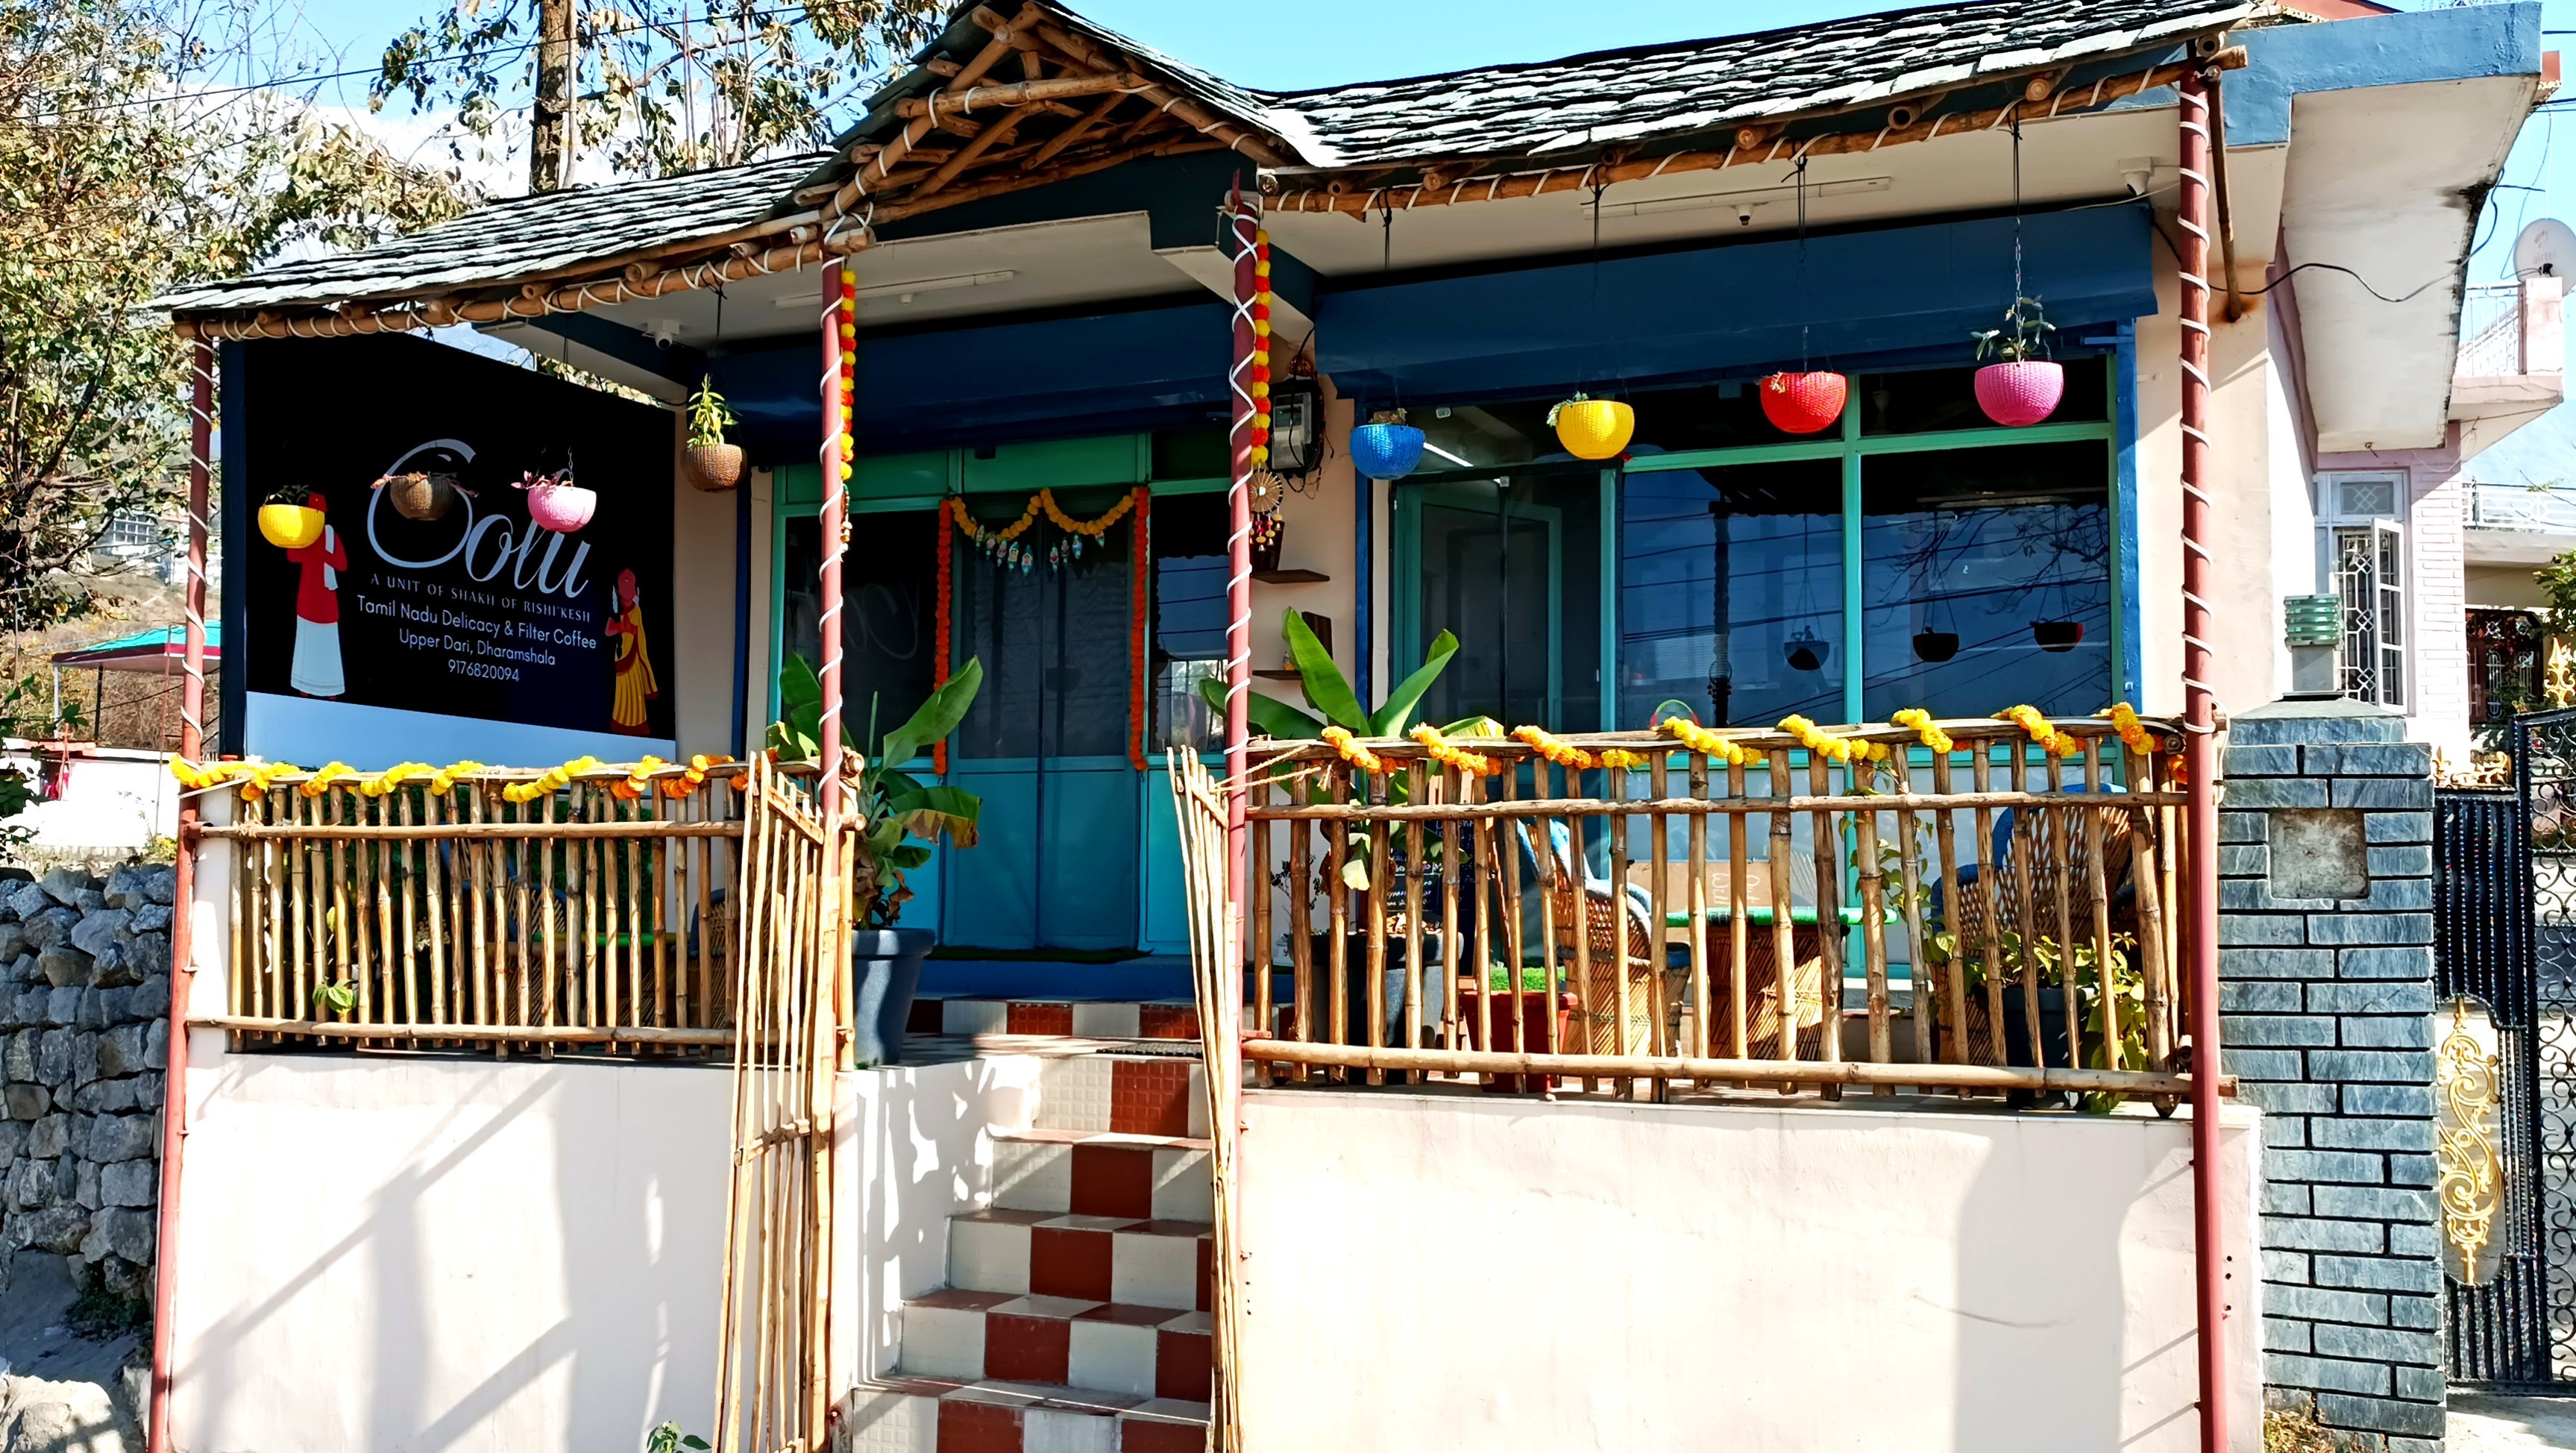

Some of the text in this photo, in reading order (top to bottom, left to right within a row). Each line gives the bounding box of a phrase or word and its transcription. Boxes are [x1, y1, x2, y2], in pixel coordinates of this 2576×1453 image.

[371, 573, 379, 586] A
[387, 576, 420, 591] UNIT
[427, 583, 444, 596] OF
[451, 588, 495, 606] SHAKH
[501, 597, 518, 609] OF
[357, 594, 597, 649] Tamil Nadu Delicacy & Filter Coffee
[400, 628, 556, 665] Upper Dari, Dharamshala
[448, 659, 520, 682] 9176820094
